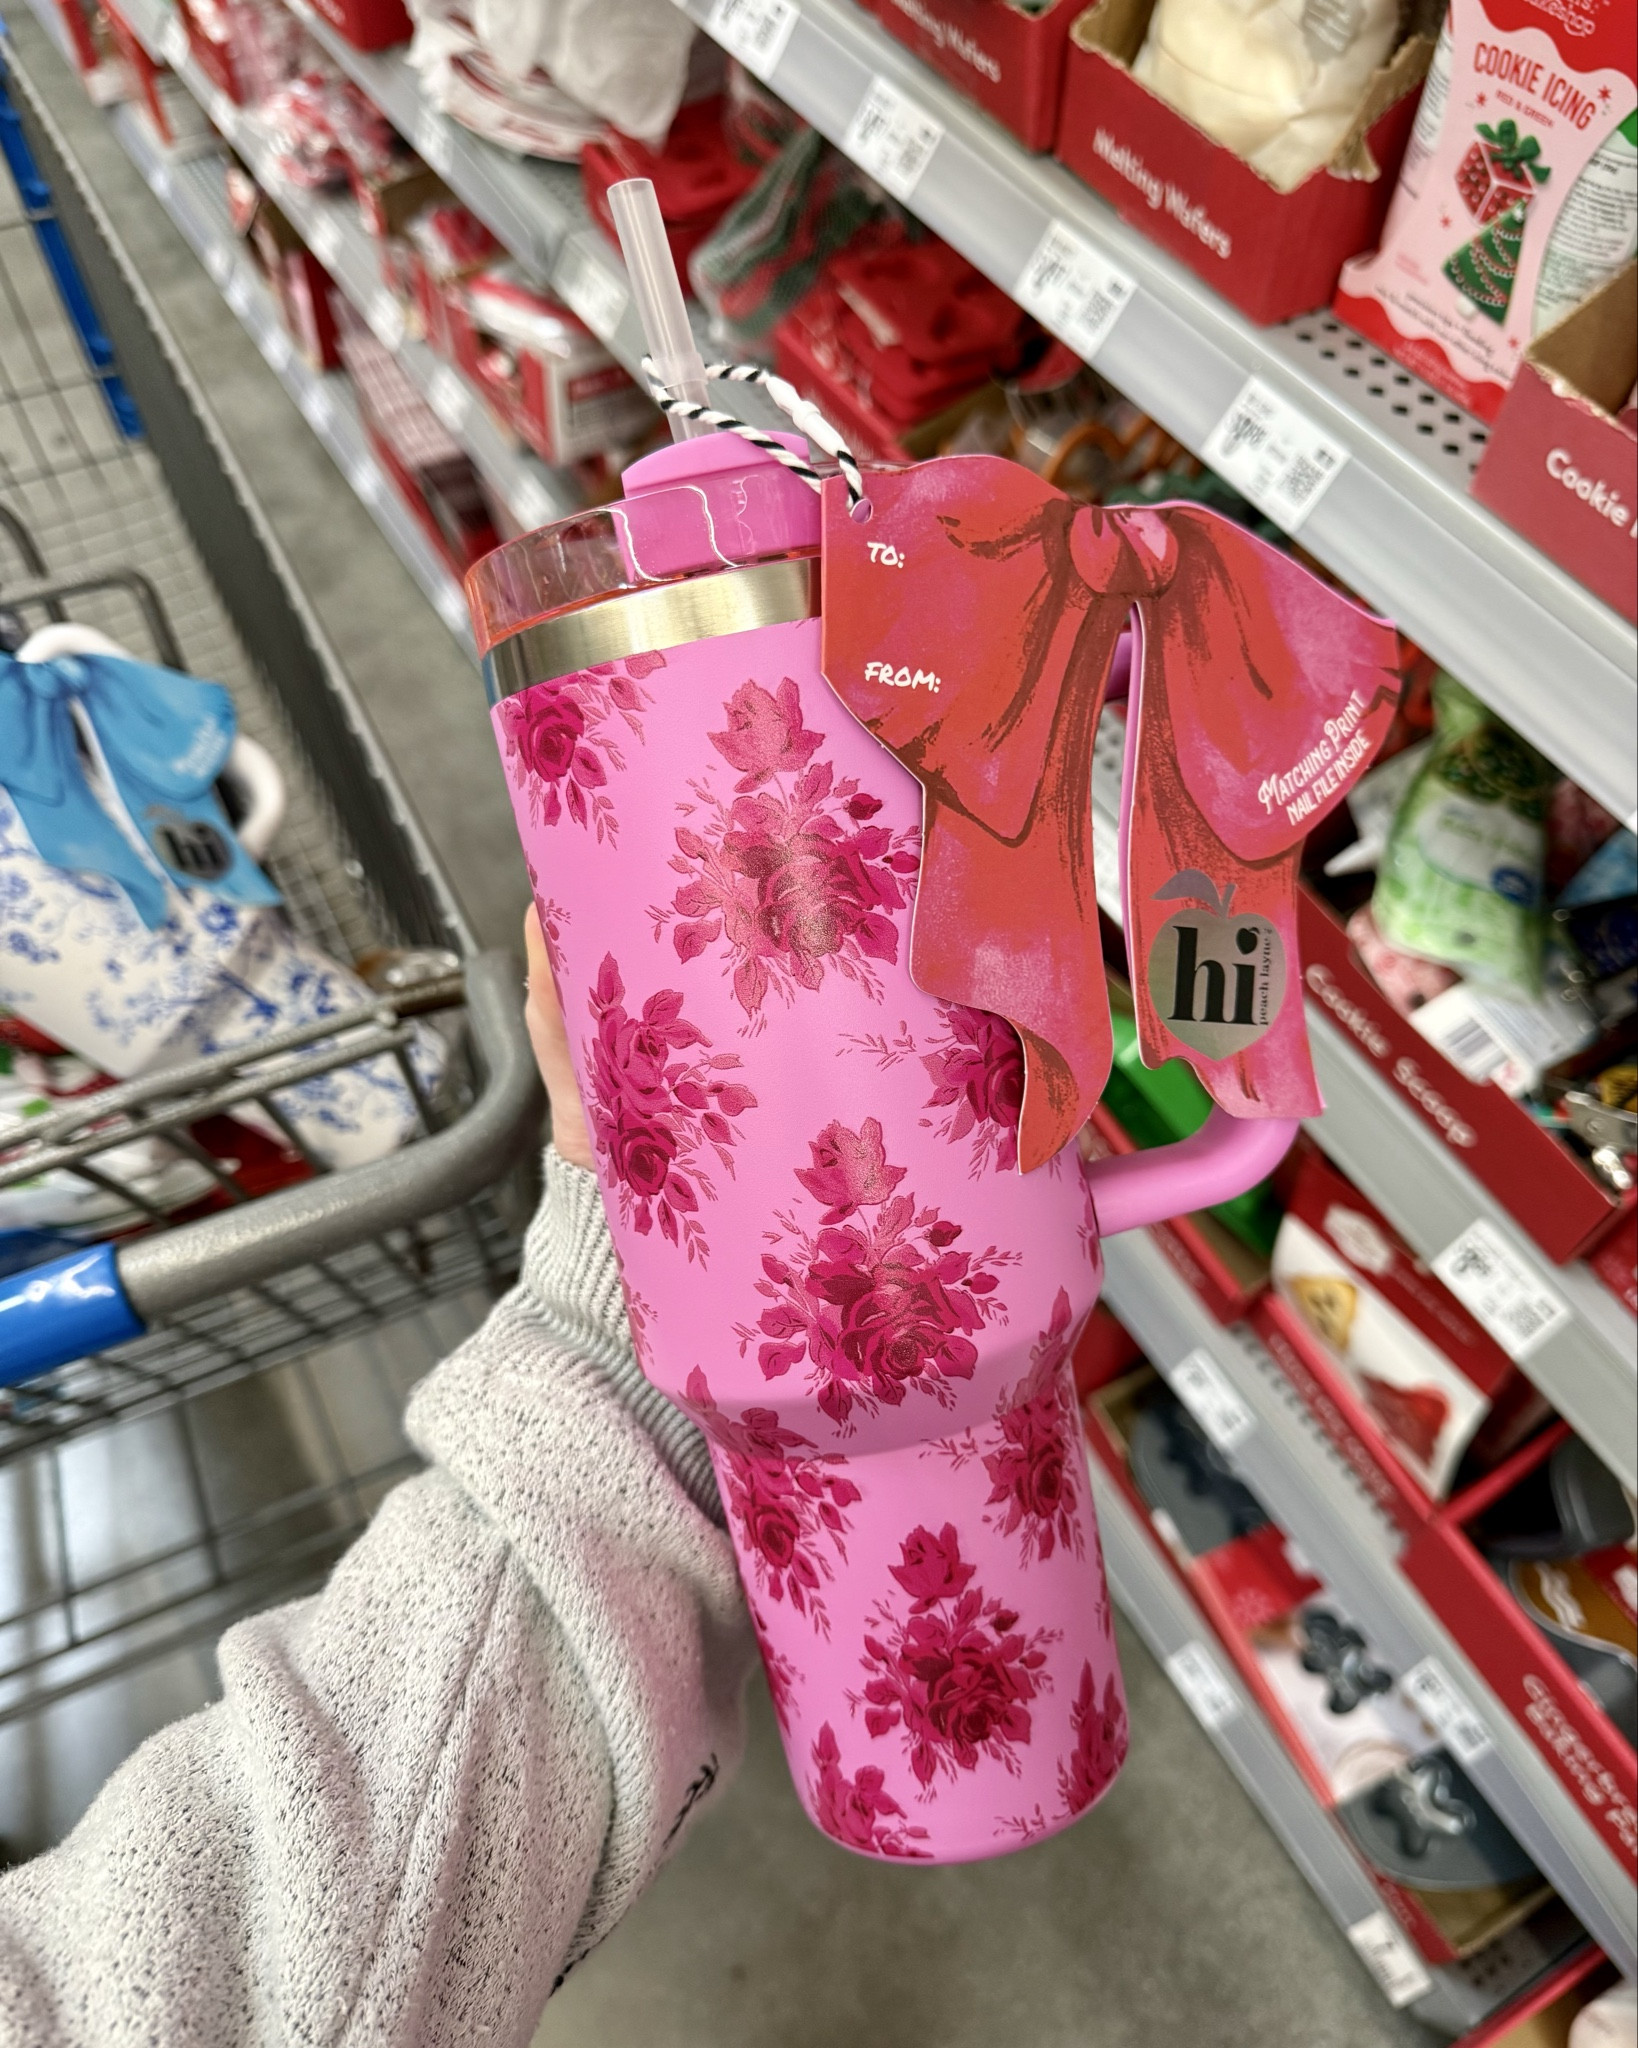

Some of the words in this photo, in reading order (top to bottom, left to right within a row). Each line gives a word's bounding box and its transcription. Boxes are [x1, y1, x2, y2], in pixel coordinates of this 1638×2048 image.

[1474, 42, 1544, 95] COOKIE
[1542, 73, 1597, 131] ICING
[1093, 125, 1164, 210] Melting
[1165, 179, 1232, 259] Wafers
[1545, 446, 1630, 527] Cookie
[866, 541, 906, 569] TO:
[864, 661, 942, 694] FROM:
[1257, 738, 1333, 815] MATCHING
[1323, 689, 1365, 752] PRINT
[1286, 790, 1319, 826] NAIL
[1312, 767, 1340, 804] FILE
[1332, 728, 1372, 782] INSIDE
[1167, 925, 1260, 1026] hi
[1259, 938, 1273, 977] layne
[1259, 981, 1270, 1026] peach
[1306, 963, 1392, 1060] Cookie
[1392, 1056, 1479, 1149] Scoop
